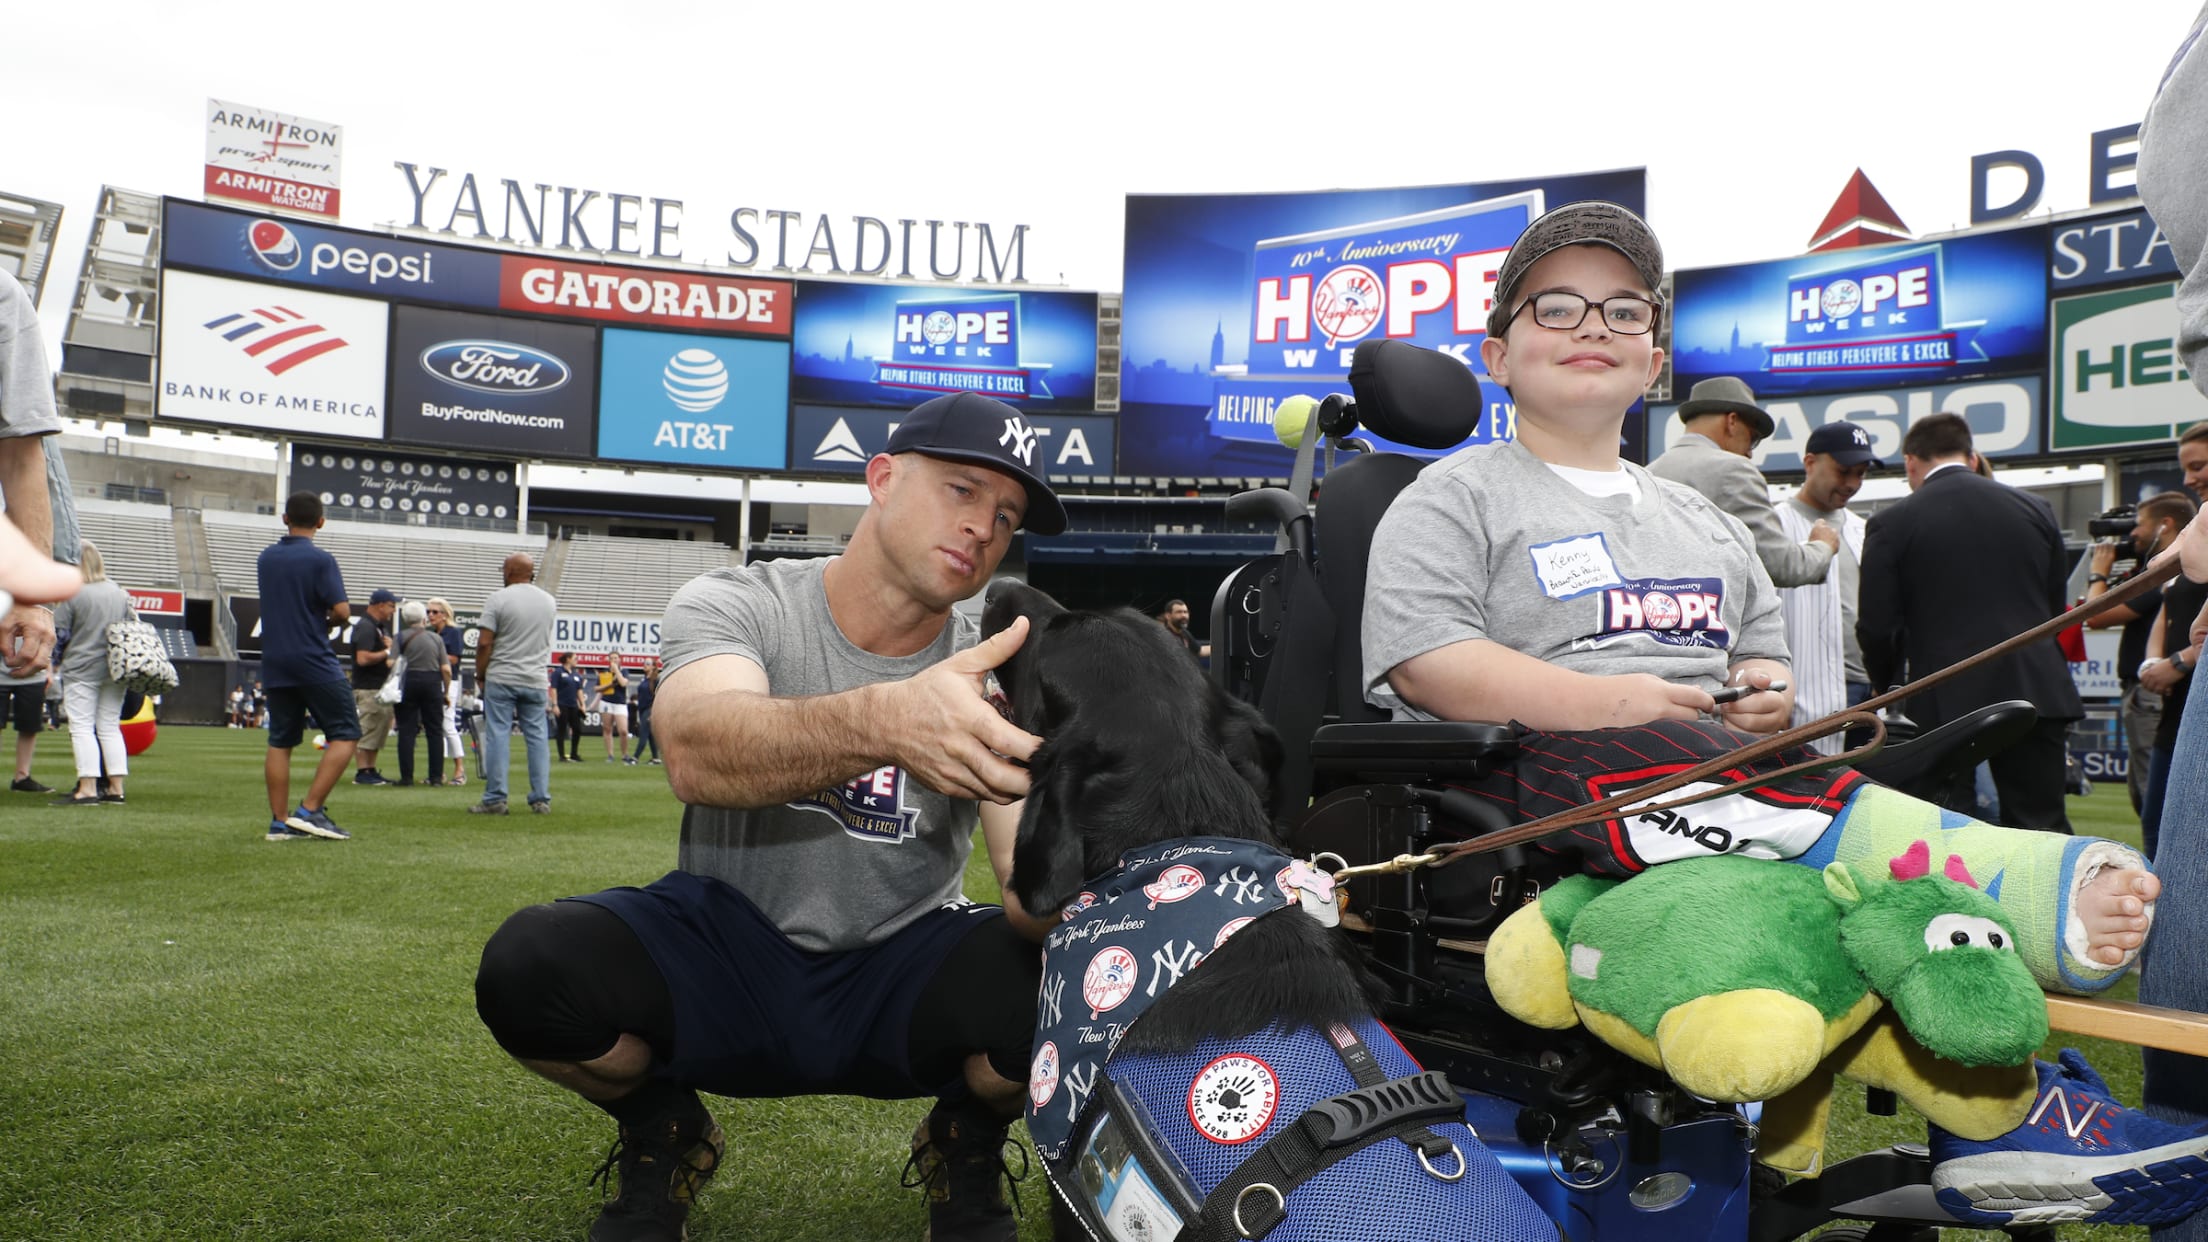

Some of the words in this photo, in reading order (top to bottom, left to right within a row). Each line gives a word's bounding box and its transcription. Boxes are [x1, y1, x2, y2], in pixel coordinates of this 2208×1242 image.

[212, 109, 336, 147] ARMITRON
[216, 171, 330, 204] ARMITRON
[271, 194, 325, 212] WATCHES
[394, 160, 684, 260] YANKEE
[727, 205, 1031, 285] STADIUM
[311, 241, 432, 284] pepsi
[1290, 247, 1326, 268] 10th
[1326, 232, 1462, 264] Anniversary
[521, 267, 775, 323] GATORADE
[1790, 266, 1929, 324] HOPE
[897, 310, 1010, 346] HOPE
[1806, 312, 1907, 333] WEEK
[909, 345, 992, 357] WEEK
[1283, 342, 1473, 368] WEK
[1772, 351, 1804, 367] HELPING
[1806, 349, 1839, 366] OTHERS
[1842, 344, 1897, 364] PERSEVERE
[1901, 344, 1909, 361] &
[1914, 341, 1951, 361] EXCEL
[2076, 337, 2192, 393] HE
[450, 346, 544, 389] Ford
[880, 368, 907, 382] HELPING
[909, 370, 936, 385] OTHERS
[939, 373, 984, 390] PERSEVERE
[987, 377, 994, 390] &
[997, 376, 1025, 393] EXCEL
[166, 381, 231, 402] BANK
[240, 391, 267, 405] OF
[275, 394, 377, 419] AMERICA
[422, 402, 564, 429] BuyFordNow.com
[1218, 393, 1274, 425] HELPING
[653, 420, 734, 452] AT&T
[360, 475, 384, 488] New
[382, 477, 409, 494] York
[410, 480, 453, 497] Yankees
[1549, 551, 1591, 571] Kenny
[1643, 580, 1702, 592] Anniversary
[1608, 590, 1726, 631] HOPE
[556, 643, 626, 653] DISCOVERY
[875, 820, 897, 834] EXCEL
[1049, 932, 1067, 951] New
[1064, 922, 1090, 951] York
[1090, 913, 1145, 945] Yankees
[1077, 1026, 1106, 1044] New
[1203, 1073, 1212, 1081] 4
[1211, 1058, 1249, 1074] PAWS
[1251, 1063, 1272, 1087] FOR
[1194, 1087, 1206, 1122] SINCE
[1204, 1122, 1229, 1139] 1998
[1240, 1090, 1274, 1137] ABILITY
